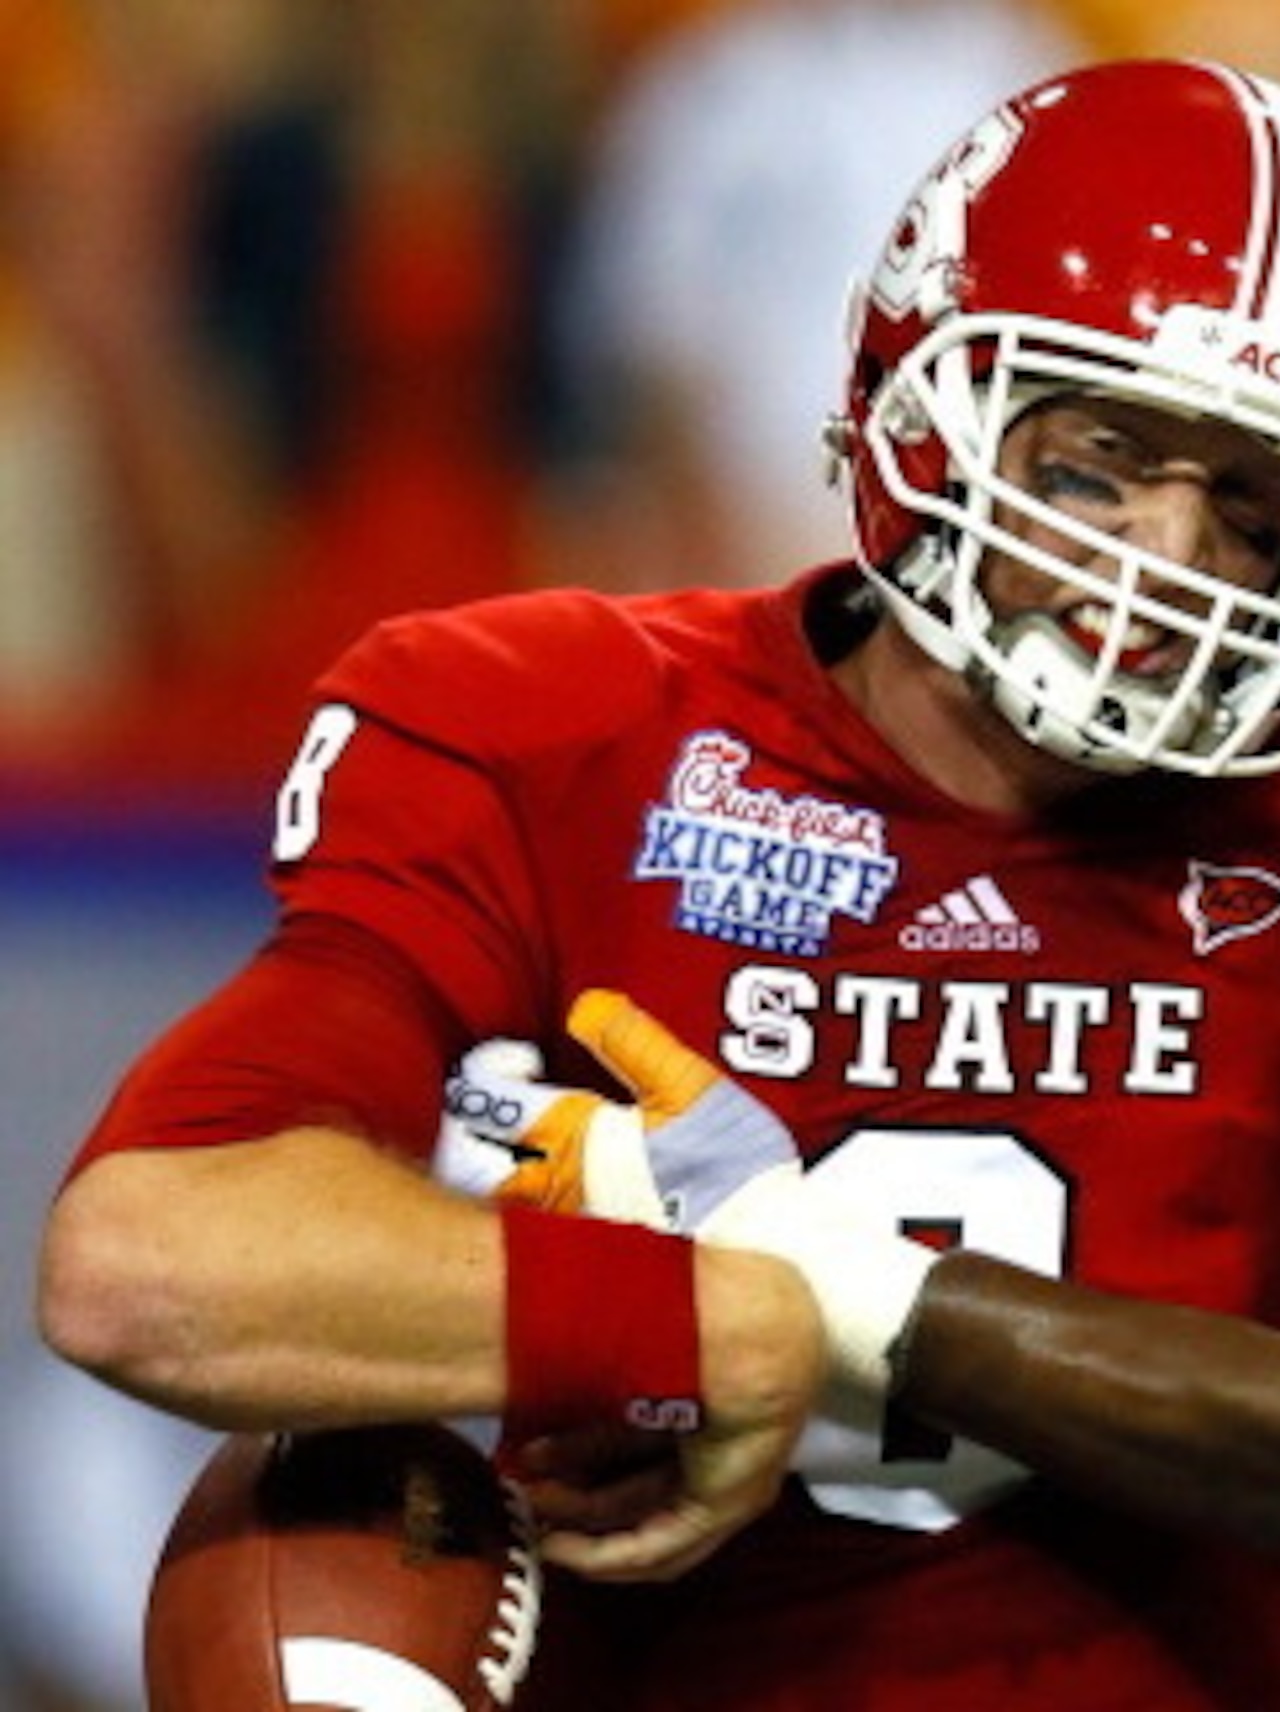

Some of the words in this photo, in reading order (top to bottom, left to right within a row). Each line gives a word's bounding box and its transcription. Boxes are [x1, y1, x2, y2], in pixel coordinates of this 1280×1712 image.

[272, 703, 357, 862] 8
[647, 816, 890, 912] KICKOFF
[689, 879, 823, 929] GAME
[899, 920, 1040, 953] adidas
[719, 965, 1202, 1095] STATE
